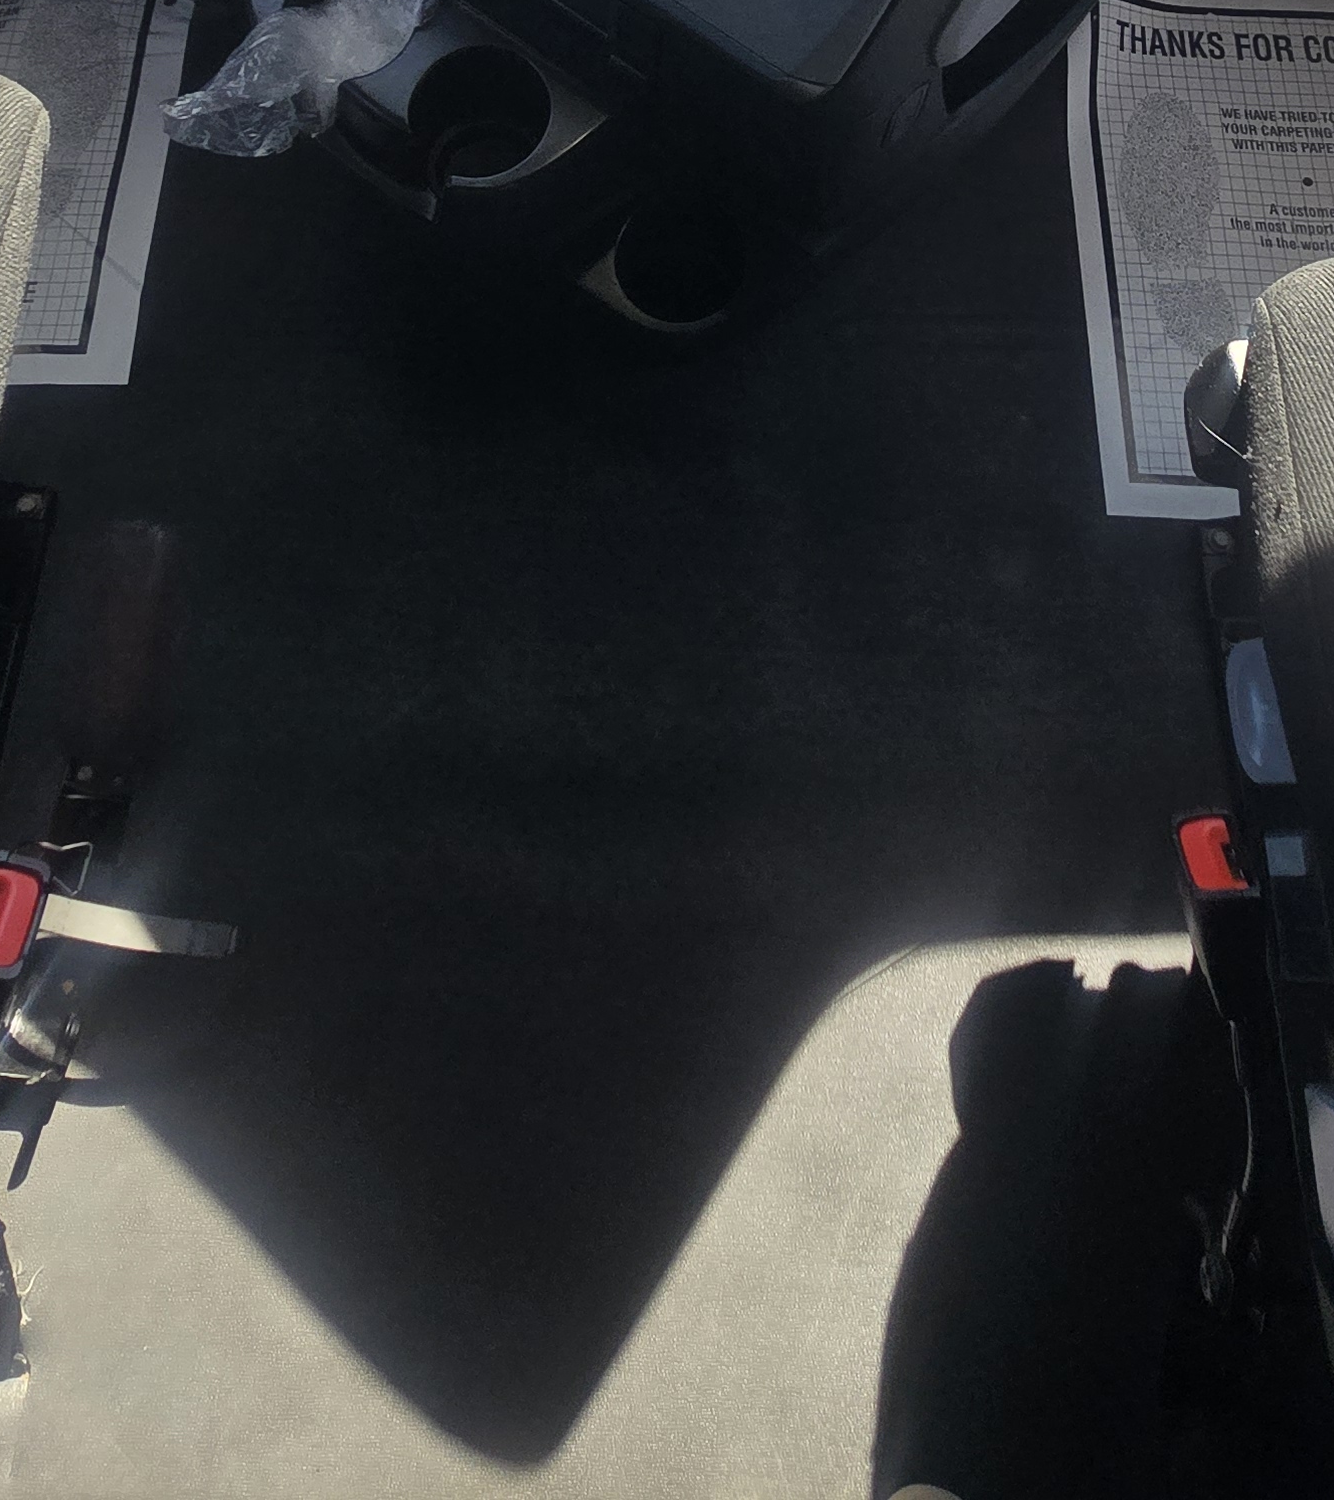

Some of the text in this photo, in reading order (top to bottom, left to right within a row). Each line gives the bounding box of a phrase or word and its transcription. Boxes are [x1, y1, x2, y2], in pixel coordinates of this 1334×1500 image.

[1116, 20, 1226, 61] THANKS
[1234, 31, 1295, 62] FOR
[1221, 107, 1242, 120] WE
[1244, 108, 1277, 122] HAVE
[1280, 110, 1318, 124] TRIED
[1222, 122, 1258, 136] YOUR
[1261, 125, 1333, 139] CARPETING
[1231, 138, 1265, 152] WITH
[1268, 140, 1298, 154] THIS
[1269, 203, 1278, 216] A
[1230, 217, 1251, 231] the
[1255, 219, 1287, 234] most
[1276, 237, 1297, 250] the
